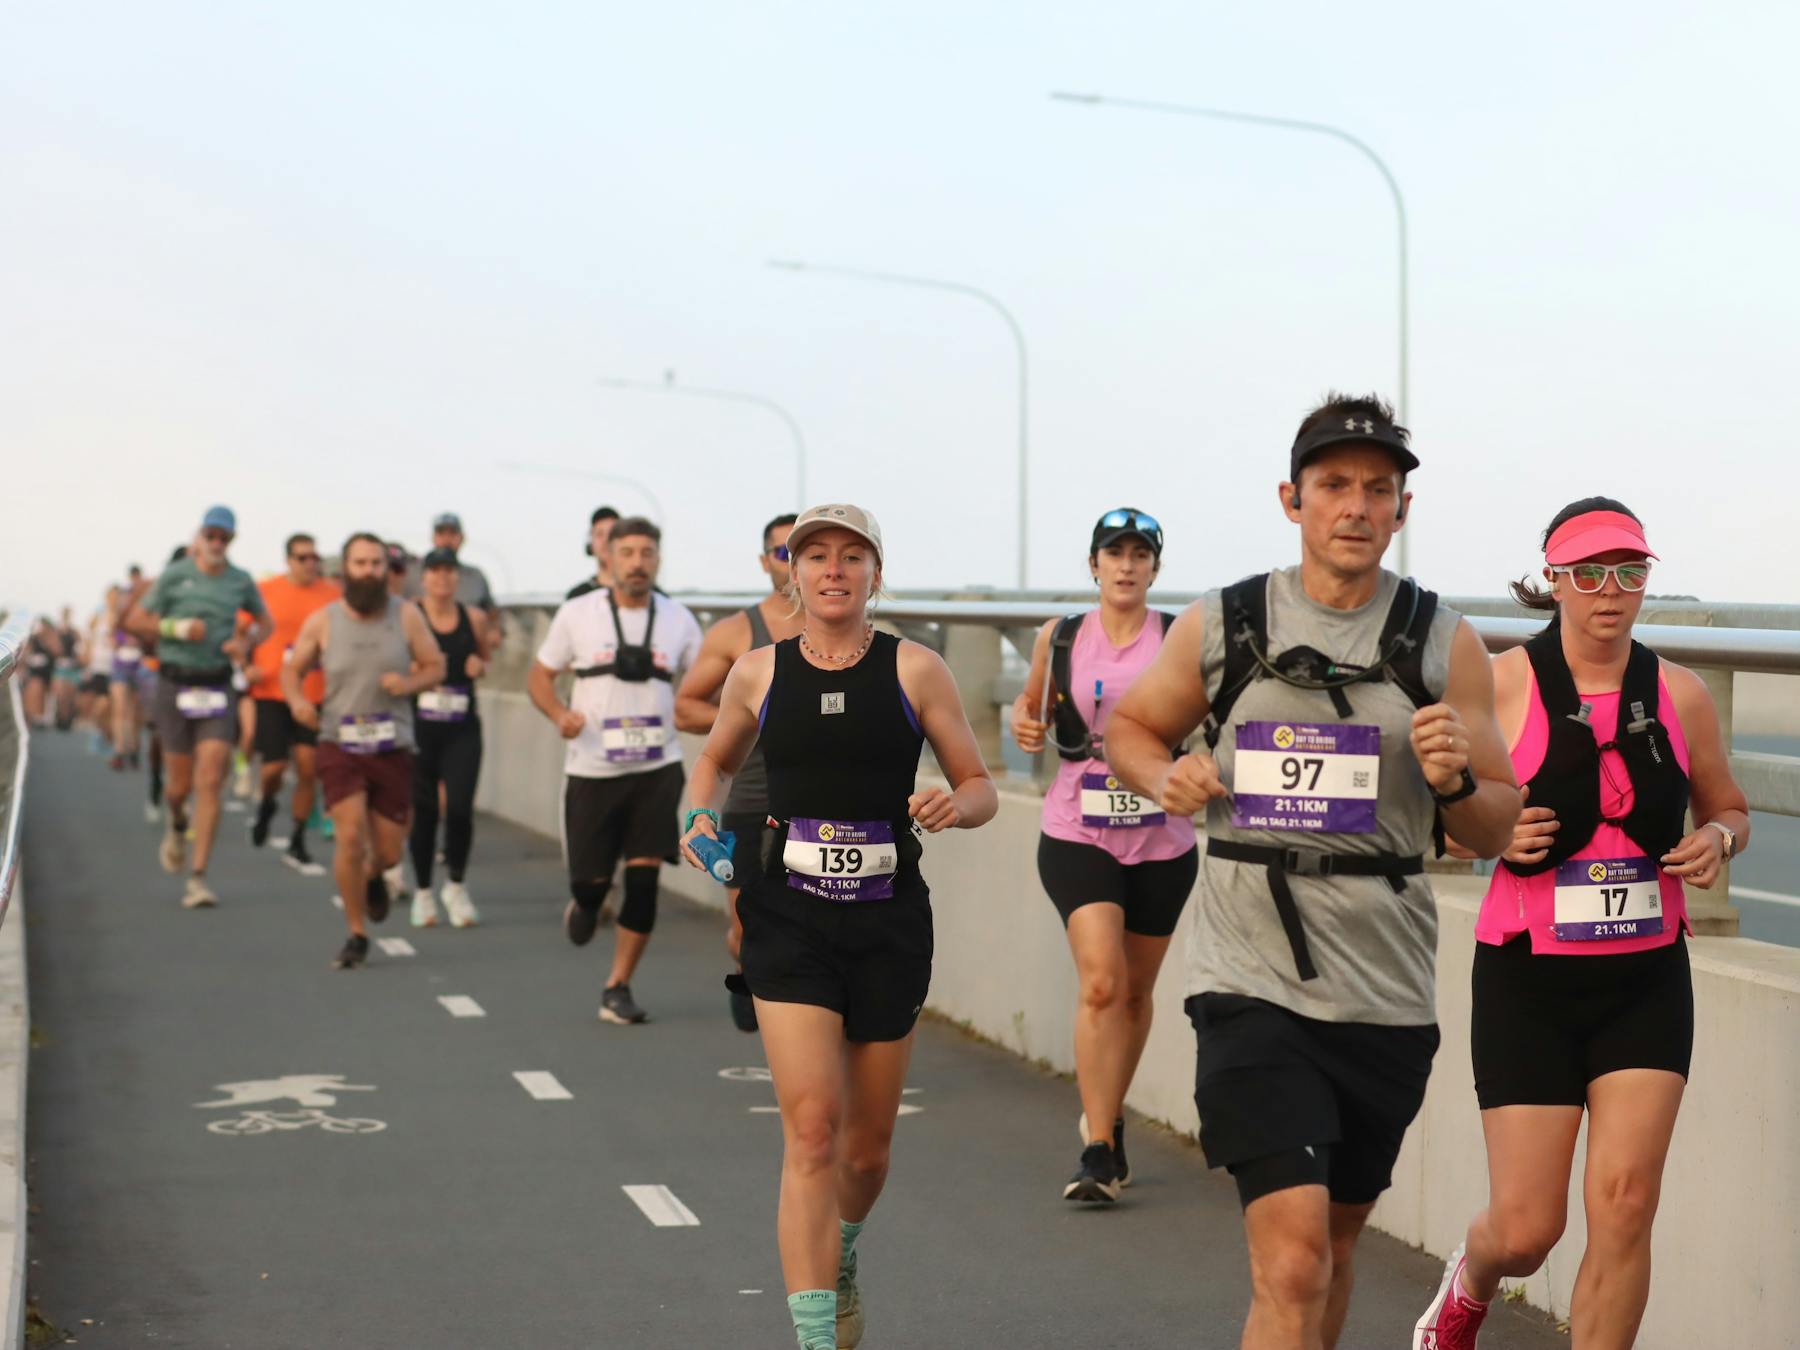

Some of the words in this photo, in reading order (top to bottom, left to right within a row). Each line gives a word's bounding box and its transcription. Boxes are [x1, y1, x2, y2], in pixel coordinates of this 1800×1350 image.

[1281, 757, 1325, 791] 97
[1108, 794, 1141, 813] 135
[1275, 799, 1329, 813] 21.1KM
[1249, 816, 1267, 826] BAG
[1269, 817, 1287, 827] TAG
[1288, 818, 1323, 828] 21.1KM
[818, 847, 863, 874] 139
[802, 883, 817, 894] BAG
[817, 889, 830, 899] TAG
[830, 893, 857, 901] 21.1KM
[819, 879, 861, 889] 21.1KM
[1600, 887, 1629, 917] 17
[1594, 923, 1638, 936] 21.1KM
